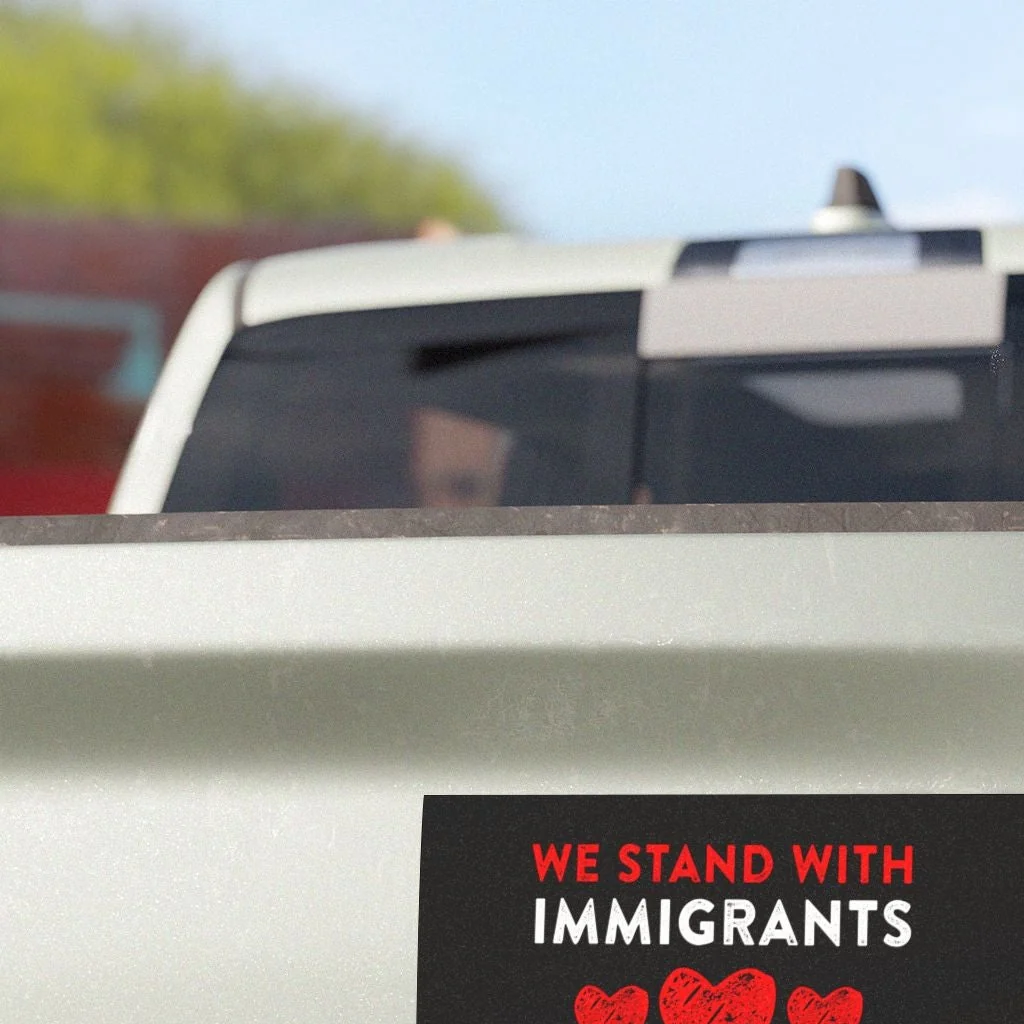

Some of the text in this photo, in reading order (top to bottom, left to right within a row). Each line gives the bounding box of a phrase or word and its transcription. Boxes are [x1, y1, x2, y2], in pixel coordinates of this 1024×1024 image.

[532, 842, 914, 885] WE STAND WITH
[533, 897, 912, 948] IMMIGRANTS
